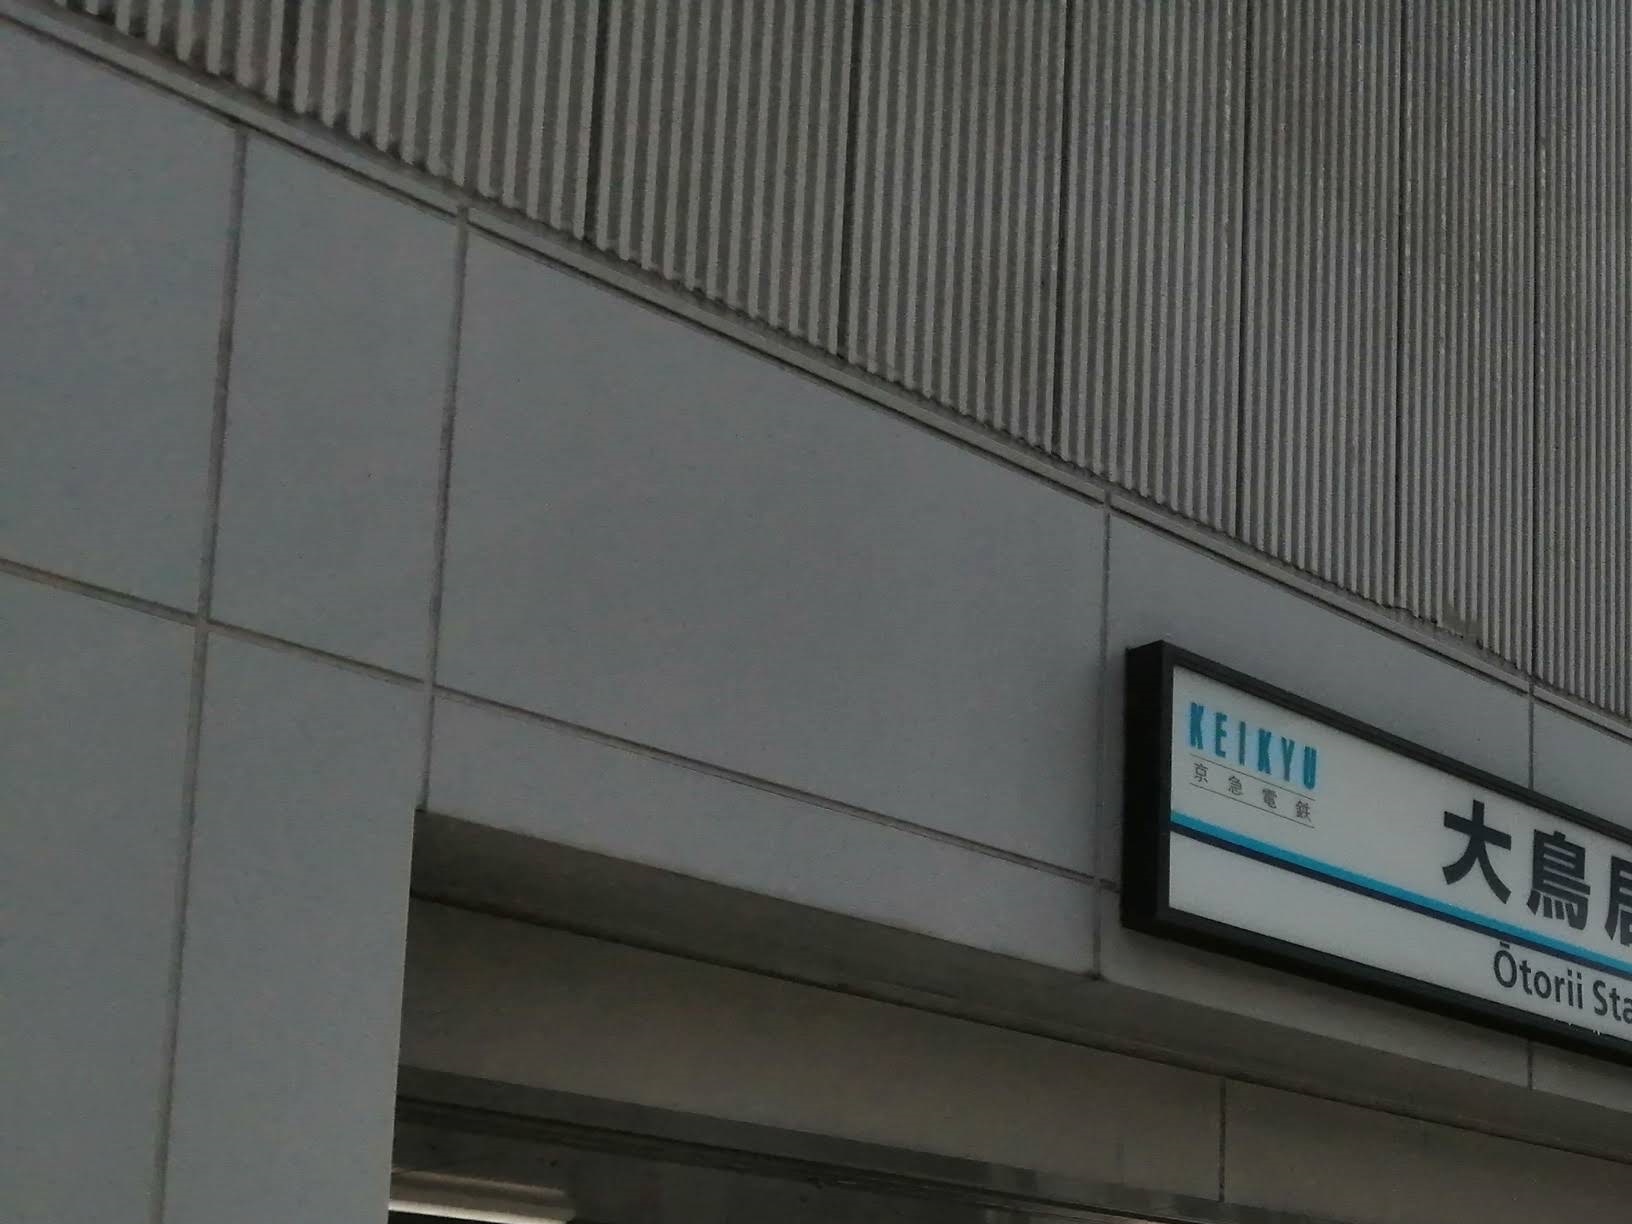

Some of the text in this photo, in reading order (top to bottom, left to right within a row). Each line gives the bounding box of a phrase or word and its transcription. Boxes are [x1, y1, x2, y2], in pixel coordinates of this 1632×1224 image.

[1187, 701, 1319, 790] KEIKYU
[1192, 762, 1313, 822] 京急電鉄
[1492, 941, 1585, 1011] Ōtorii
